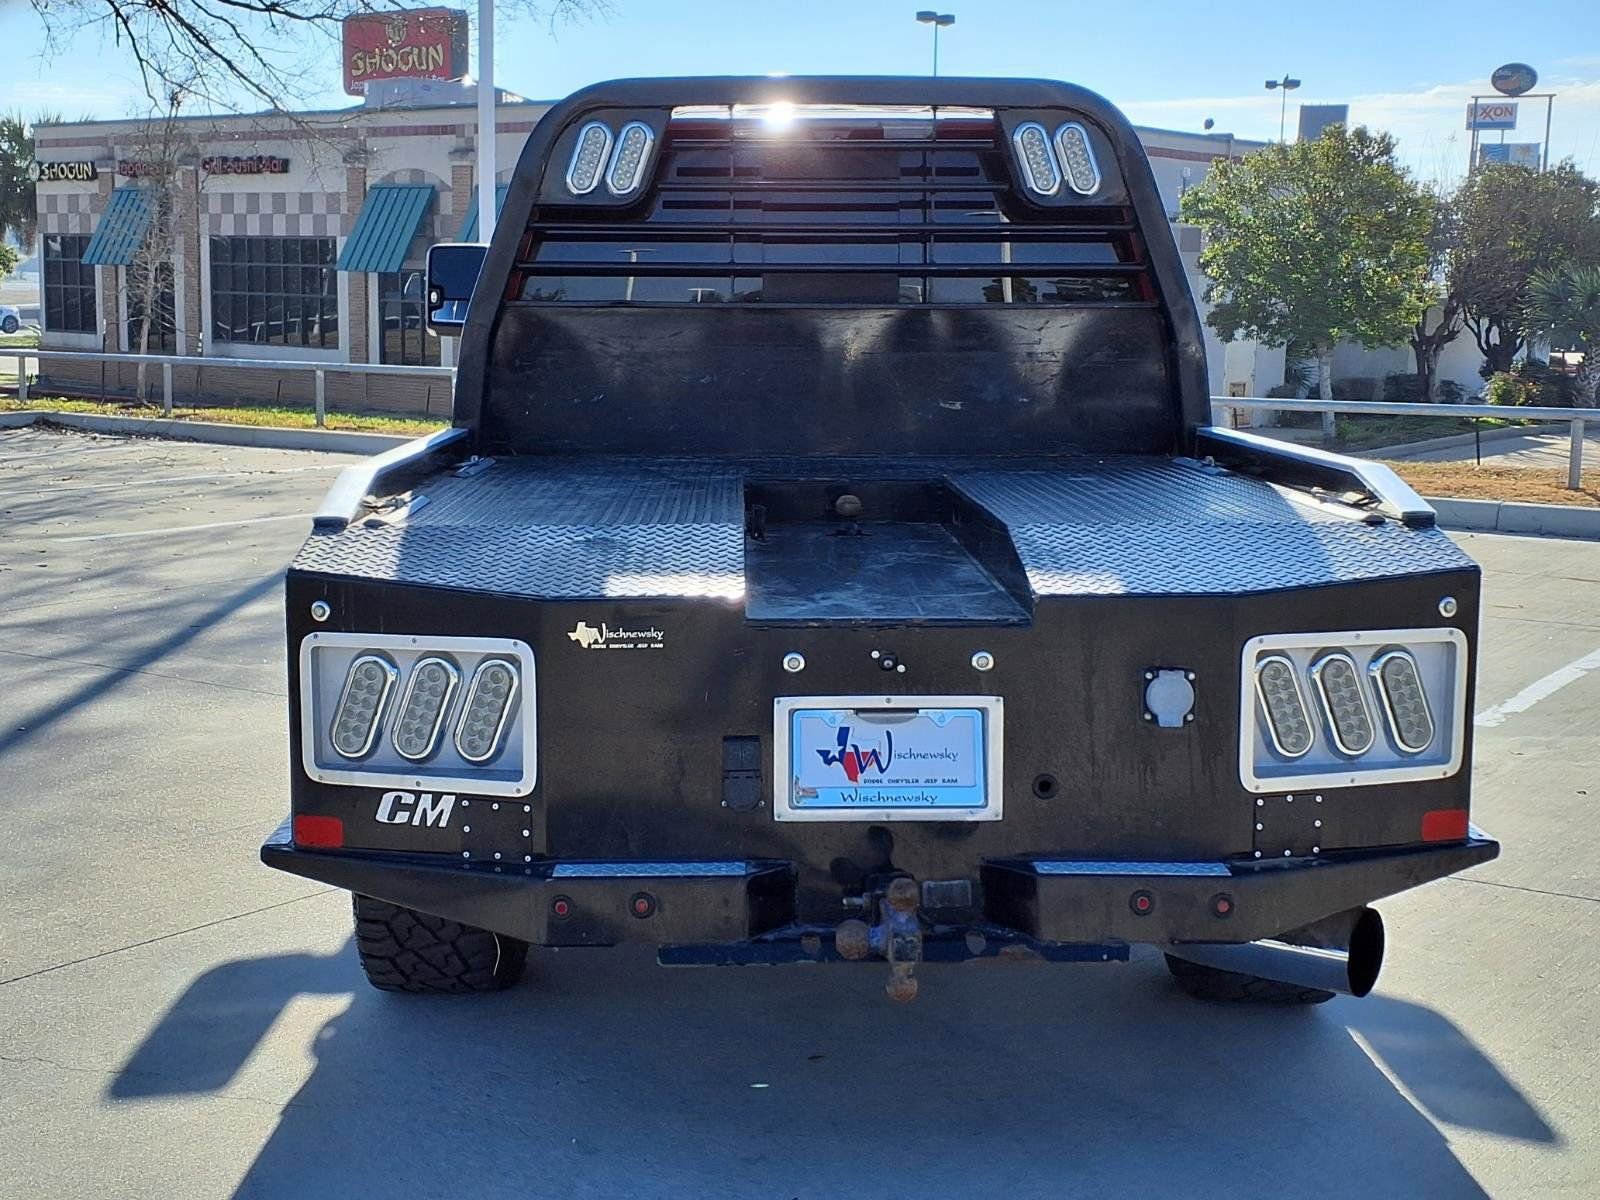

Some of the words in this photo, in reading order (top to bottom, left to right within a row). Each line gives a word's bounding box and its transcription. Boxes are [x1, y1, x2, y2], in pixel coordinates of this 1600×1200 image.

[351, 43, 444, 77] SHOGUN
[41, 161, 92, 180] SHOGUN
[851, 730, 959, 774] Wischnewsky
[375, 791, 456, 828] CM
[840, 787, 938, 805] Wischnewsky
